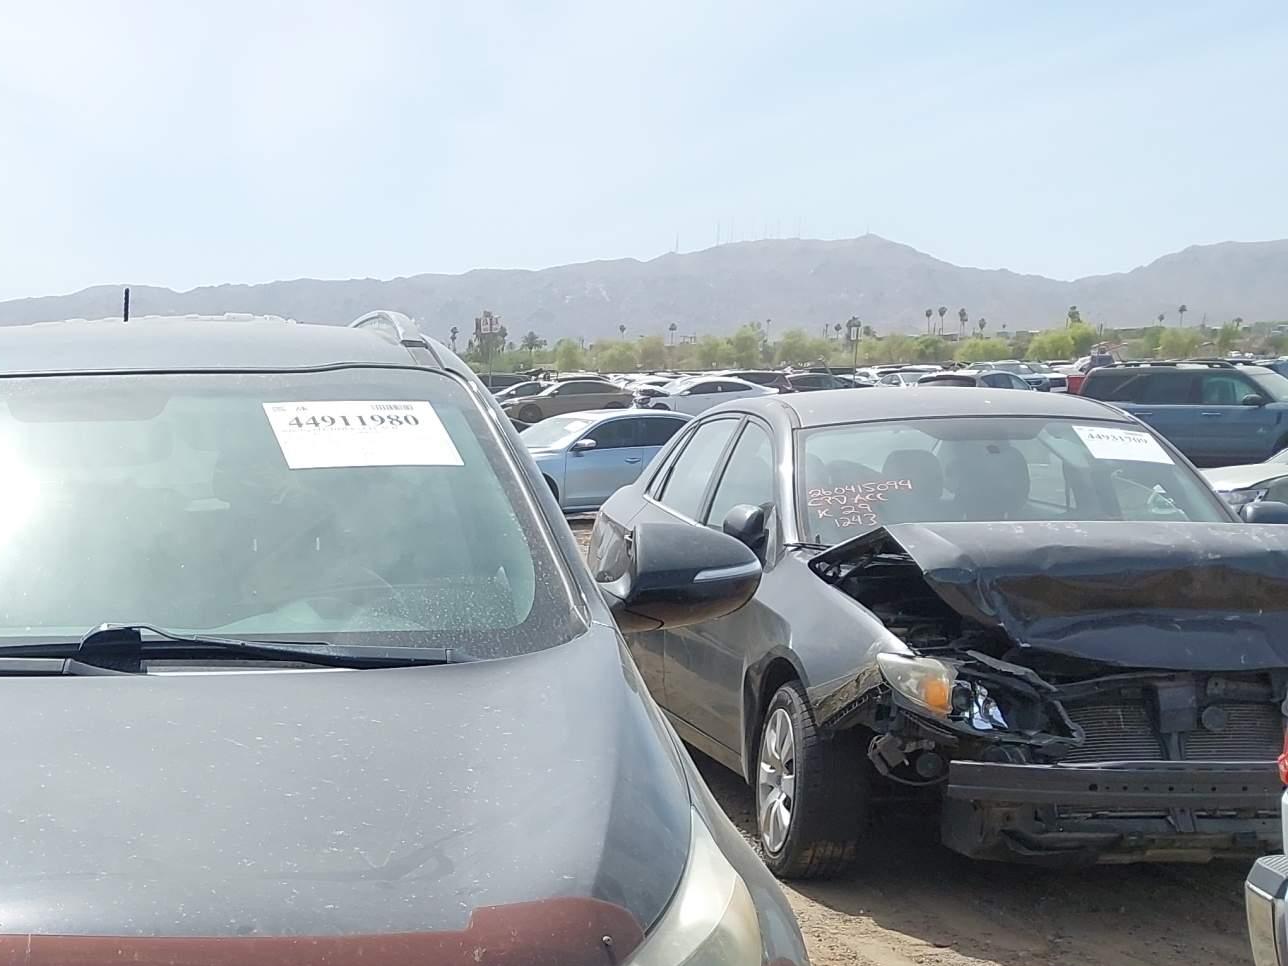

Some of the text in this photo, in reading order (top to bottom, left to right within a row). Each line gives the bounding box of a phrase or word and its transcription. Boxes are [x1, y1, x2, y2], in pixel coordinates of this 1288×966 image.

[288, 413, 420, 429] 44911980
[808, 479, 913, 497] 260415094
[839, 502, 873, 515] 29
[833, 512, 878, 528] 1243
